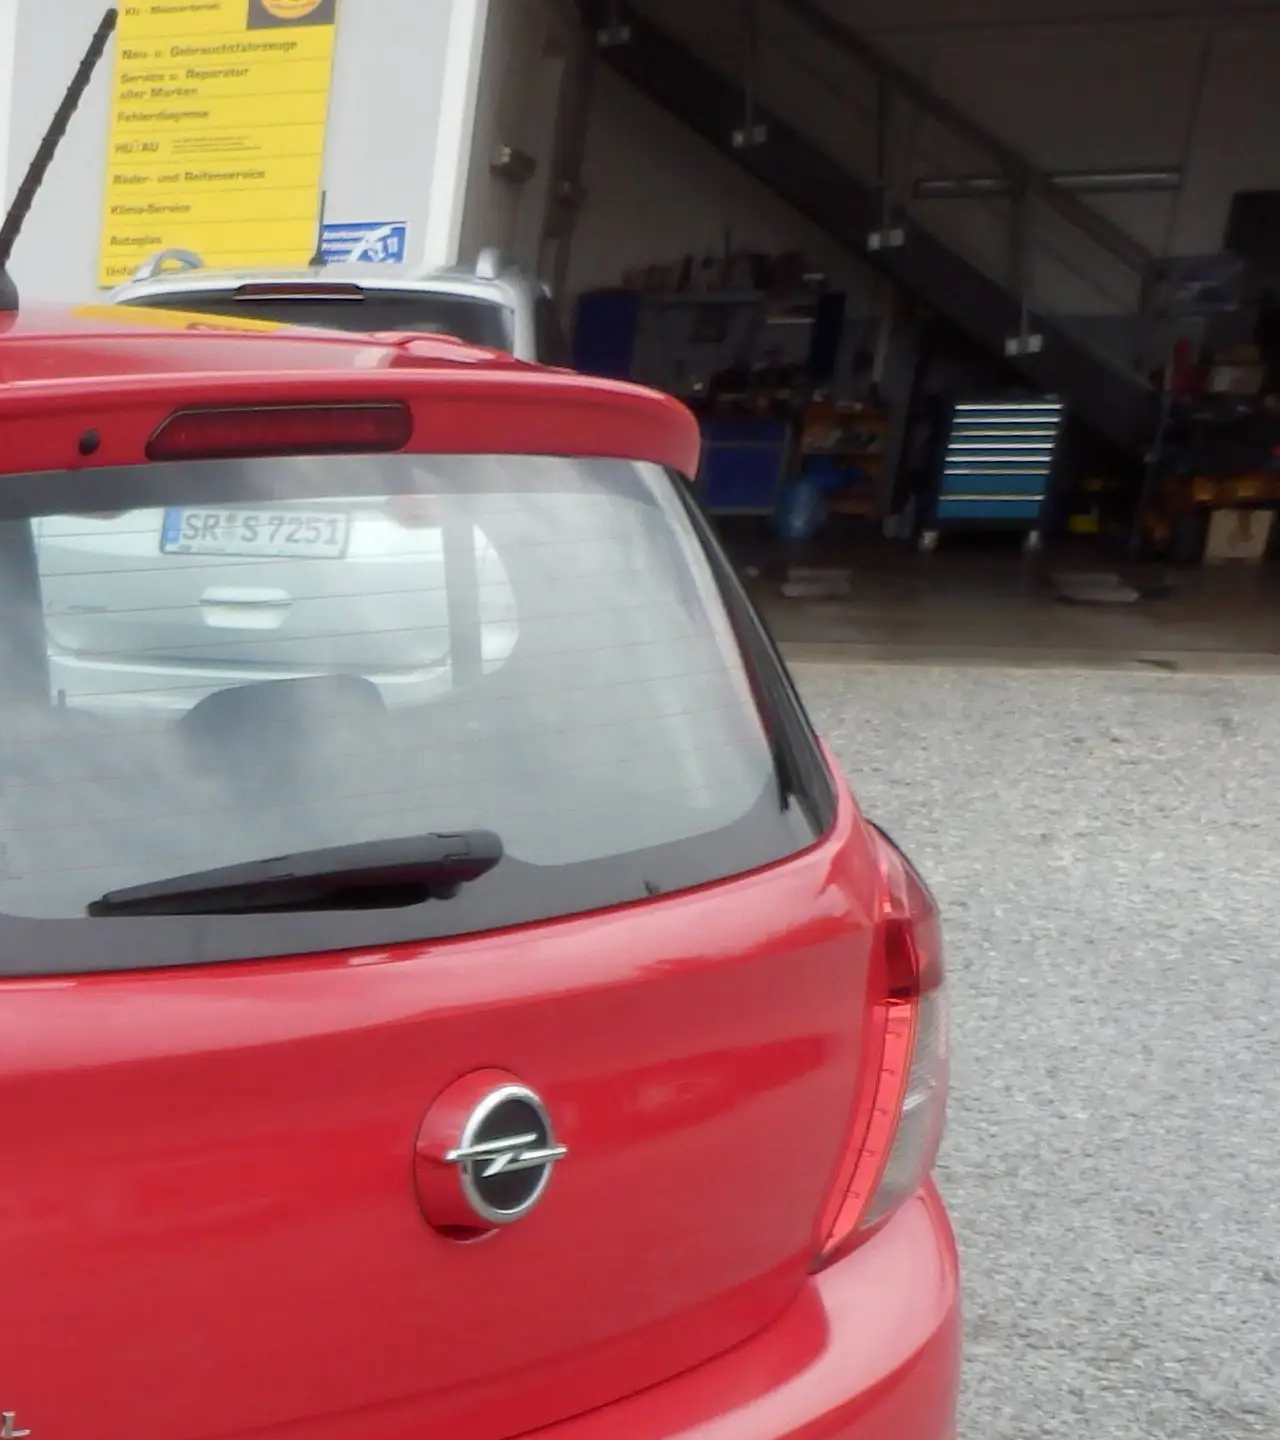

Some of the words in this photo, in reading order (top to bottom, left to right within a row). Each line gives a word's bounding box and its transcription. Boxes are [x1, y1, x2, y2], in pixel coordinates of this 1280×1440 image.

[182, 513, 220, 541] SR
[241, 515, 259, 543] S
[268, 515, 339, 545] 7251
